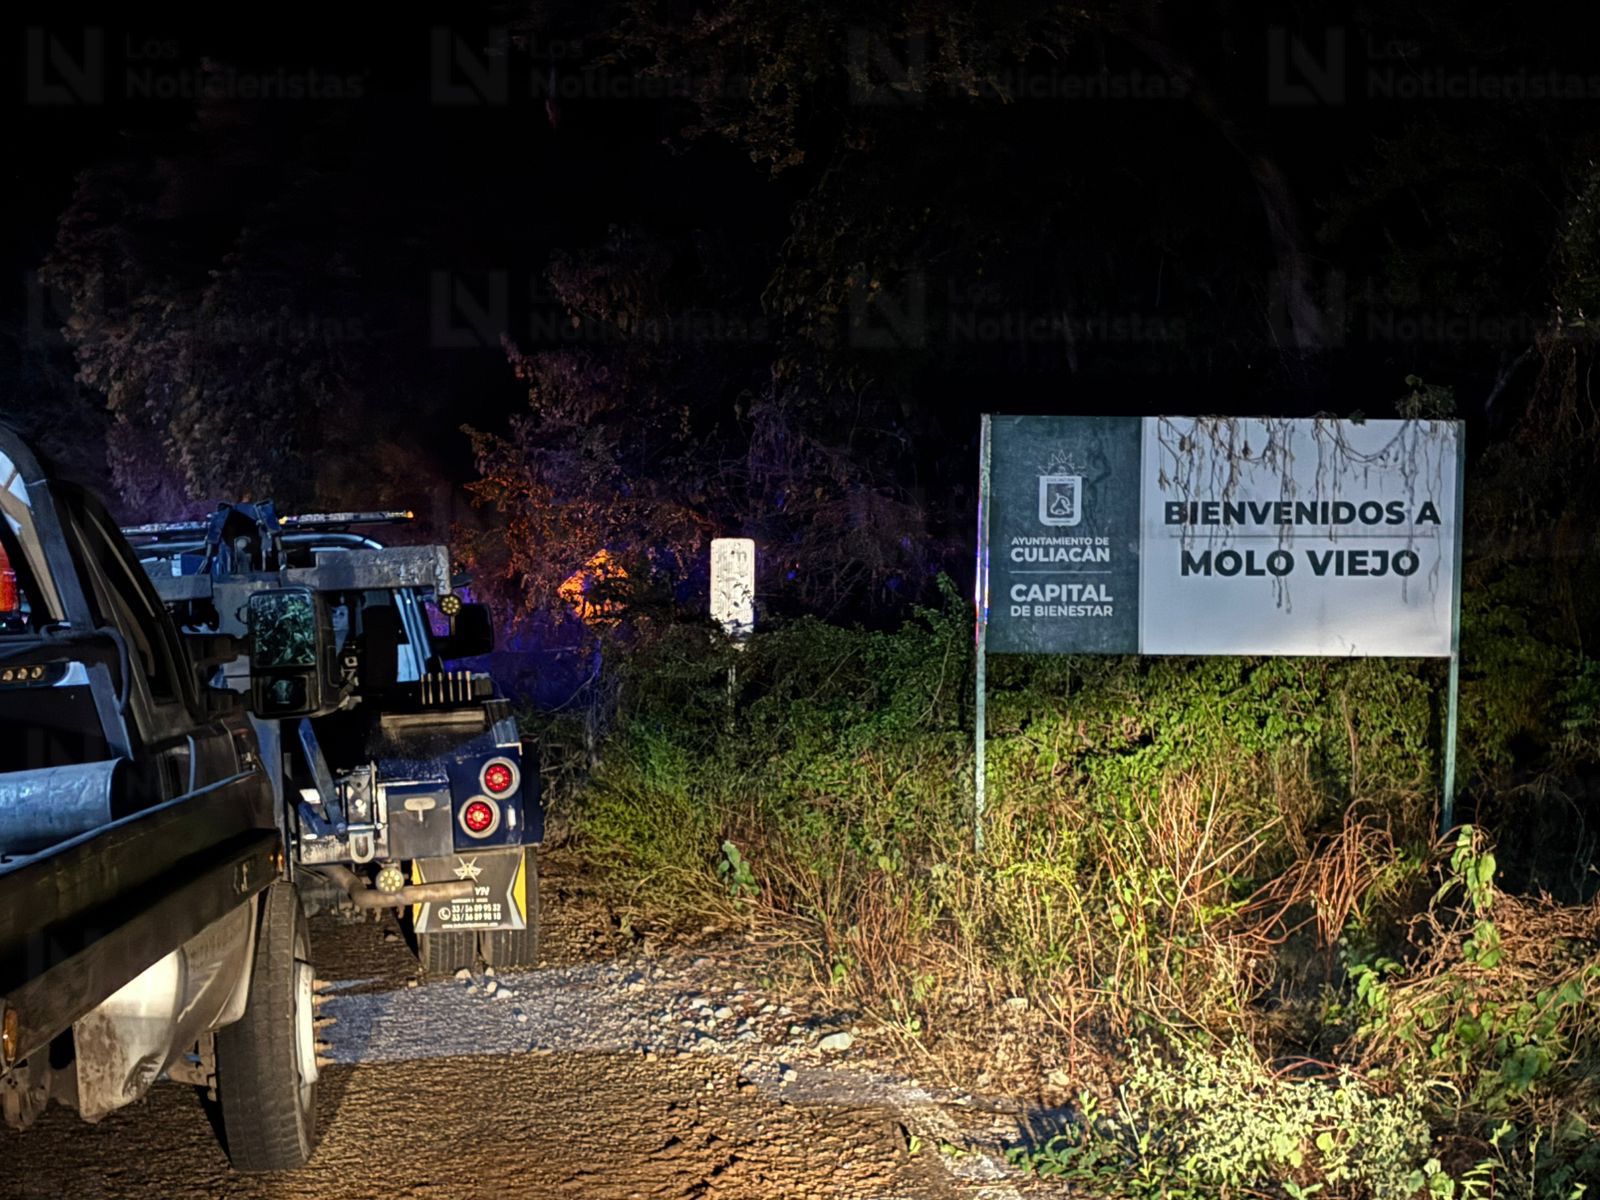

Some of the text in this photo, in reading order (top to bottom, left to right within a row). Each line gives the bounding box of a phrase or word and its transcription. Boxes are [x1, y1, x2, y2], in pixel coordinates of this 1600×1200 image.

[1164, 500, 1442, 525] BIENVENIDOS A
[1011, 536, 1109, 545] AYUNTAMIENTO DE
[1181, 549, 1420, 577] MOLO VIEJO
[1010, 584, 1113, 602] CAPITAL
[1011, 605, 1113, 617] DE BIENESTAR
